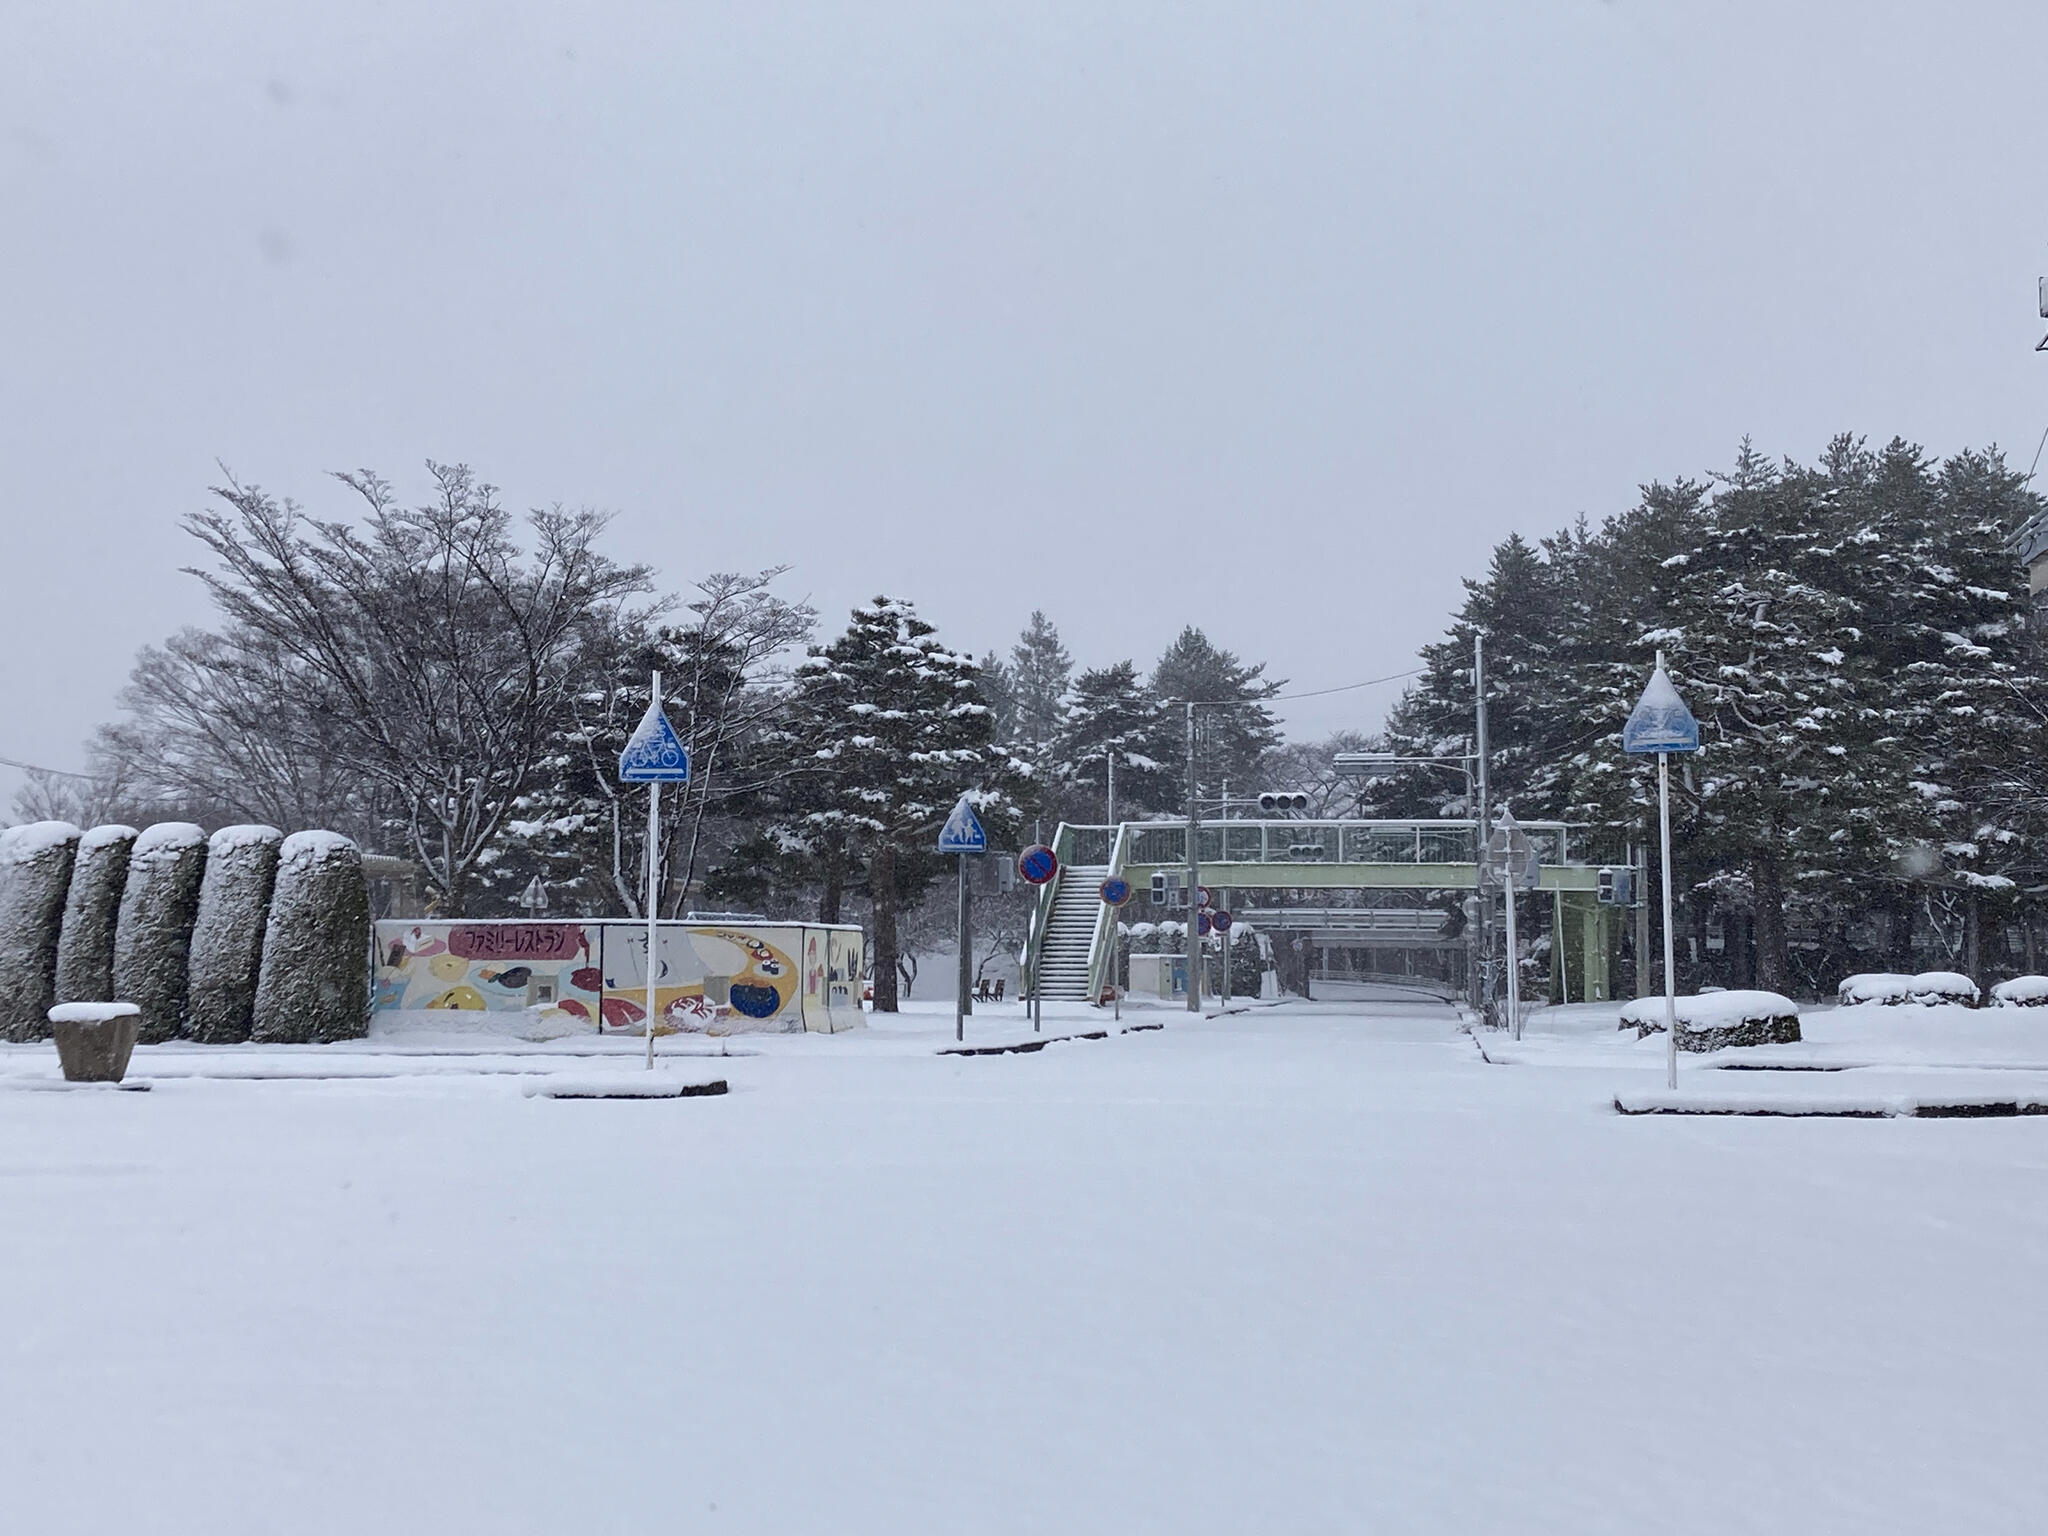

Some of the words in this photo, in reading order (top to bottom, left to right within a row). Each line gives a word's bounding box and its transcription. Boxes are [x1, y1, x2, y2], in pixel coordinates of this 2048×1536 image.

[465, 930, 565, 953] ファミリーレストラン
